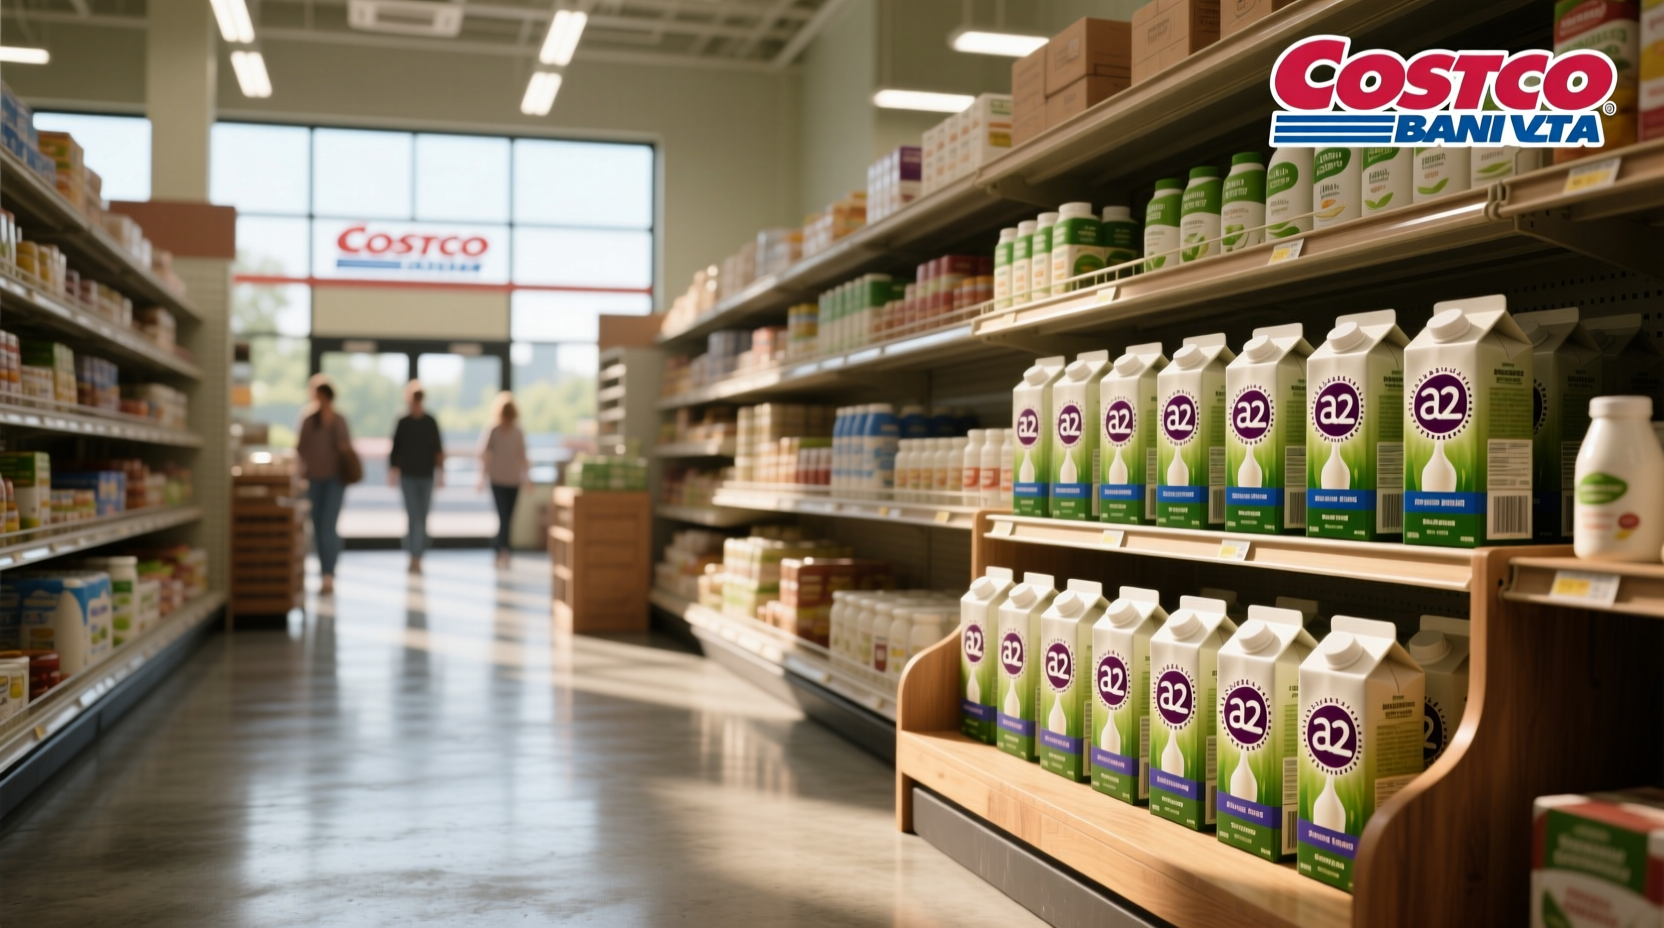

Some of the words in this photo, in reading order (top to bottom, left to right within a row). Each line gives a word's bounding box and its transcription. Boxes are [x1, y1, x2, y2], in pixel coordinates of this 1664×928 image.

[337, 227, 488, 256] COSTCO
[1166, 403, 1193, 431] a2
[1233, 400, 1267, 429] a2
[1320, 393, 1355, 424] a2
[1419, 385, 1463, 421] a2
[1018, 415, 1037, 437] a2
[1059, 412, 1081, 436] a2
[1108, 408, 1131, 434] a2
[965, 630, 983, 657] a2
[1002, 640, 1022, 667] a2
[1047, 651, 1069, 680] a2
[1100, 665, 1125, 696] a2
[1159, 681, 1191, 715] a2
[1228, 697, 1264, 735] a2
[1311, 716, 1352, 758] a2
